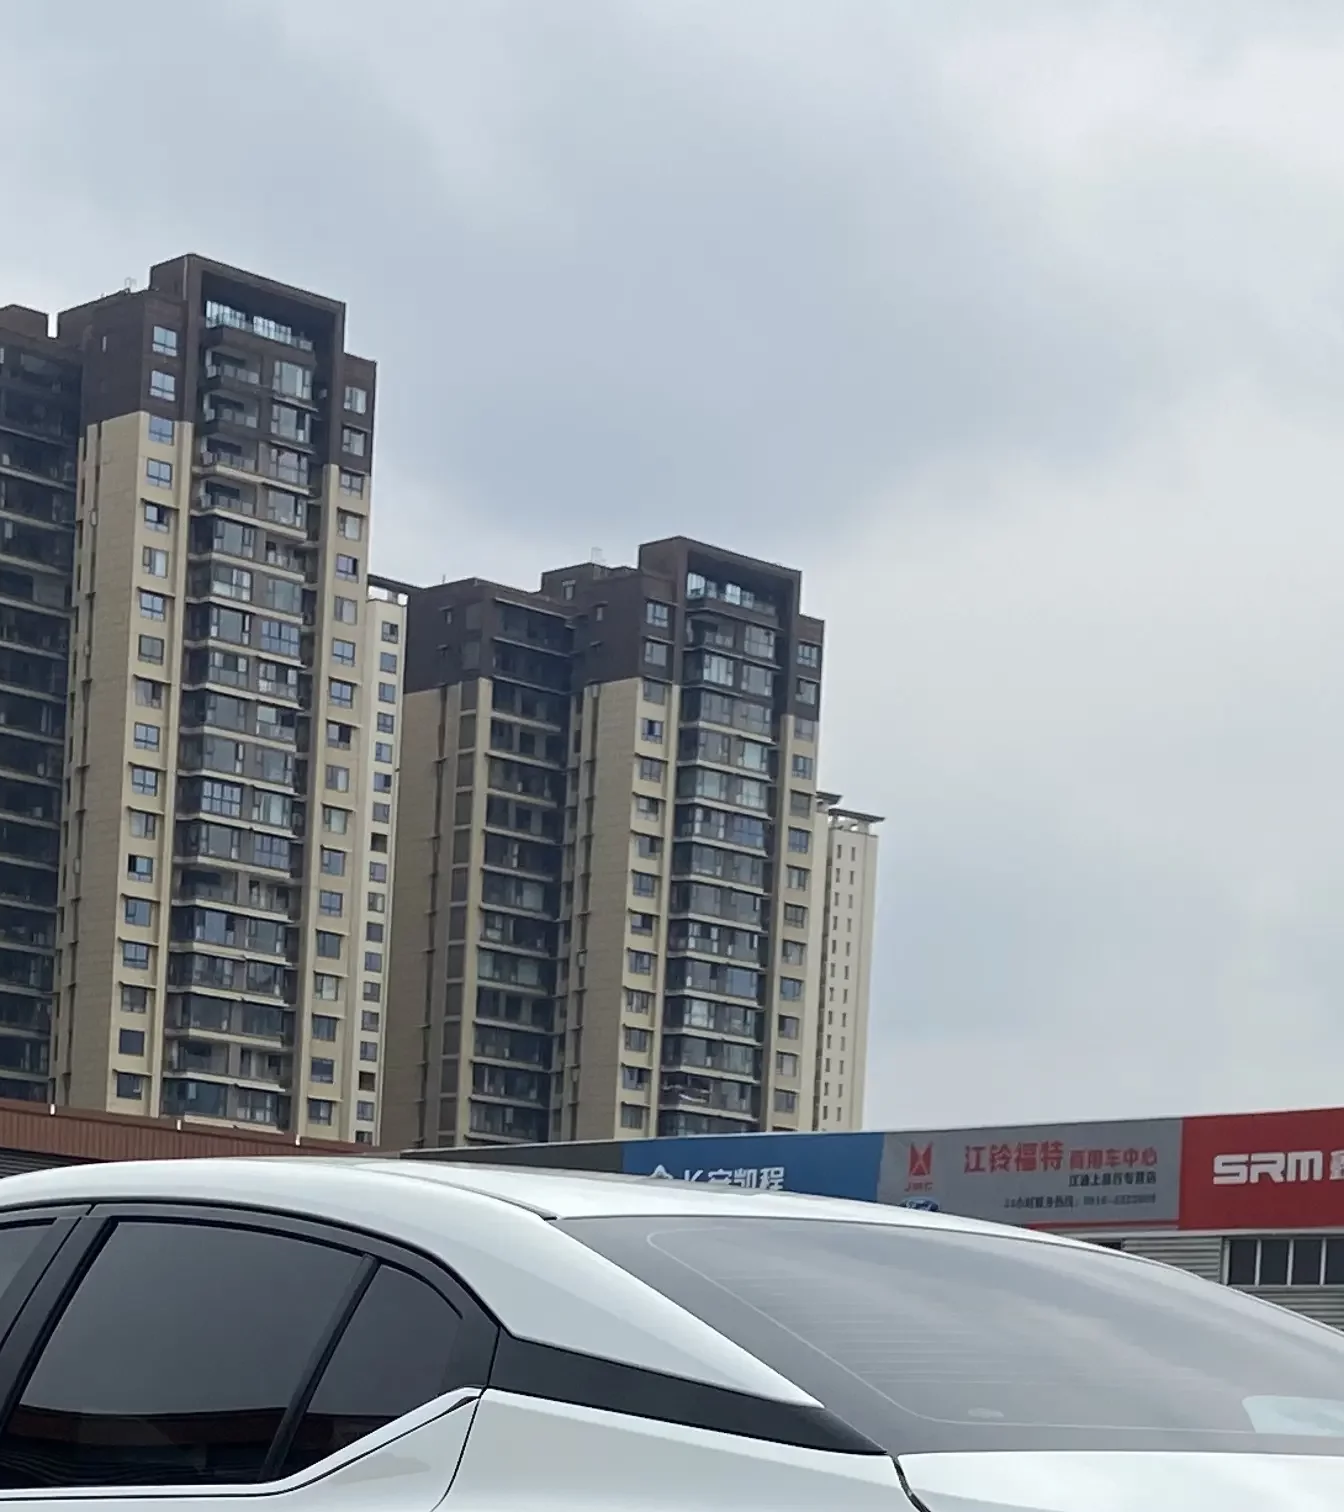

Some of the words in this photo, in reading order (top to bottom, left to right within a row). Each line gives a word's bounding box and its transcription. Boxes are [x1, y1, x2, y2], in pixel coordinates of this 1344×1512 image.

[964, 1140, 1064, 1173] 江铃福特
[1213, 1151, 1323, 1184] SRM
